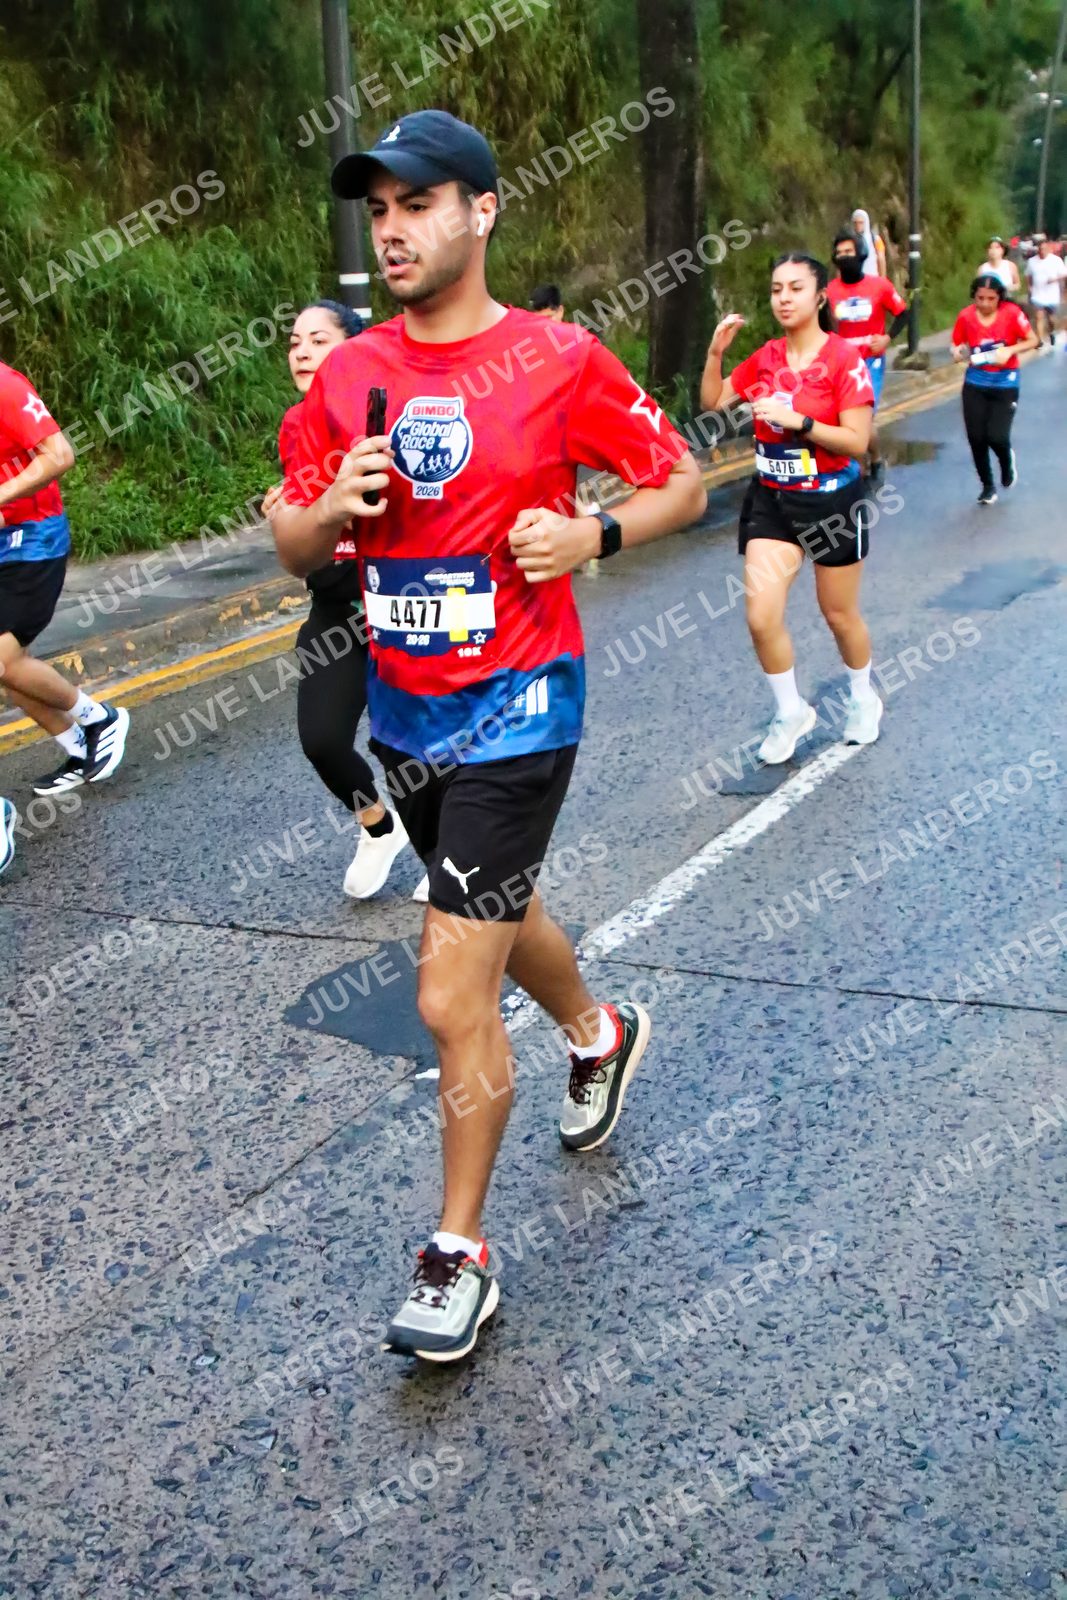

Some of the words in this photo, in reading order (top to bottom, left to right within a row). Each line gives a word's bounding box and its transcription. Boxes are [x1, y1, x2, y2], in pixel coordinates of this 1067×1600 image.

[411, 405, 455, 416] BIMBO
[410, 421, 453, 437] Global
[400, 434, 435, 450] Race
[768, 460, 796, 475] 5476
[415, 485, 440, 496] 2026
[390, 599, 442, 628] 4477
[457, 646, 482, 658] 10K
